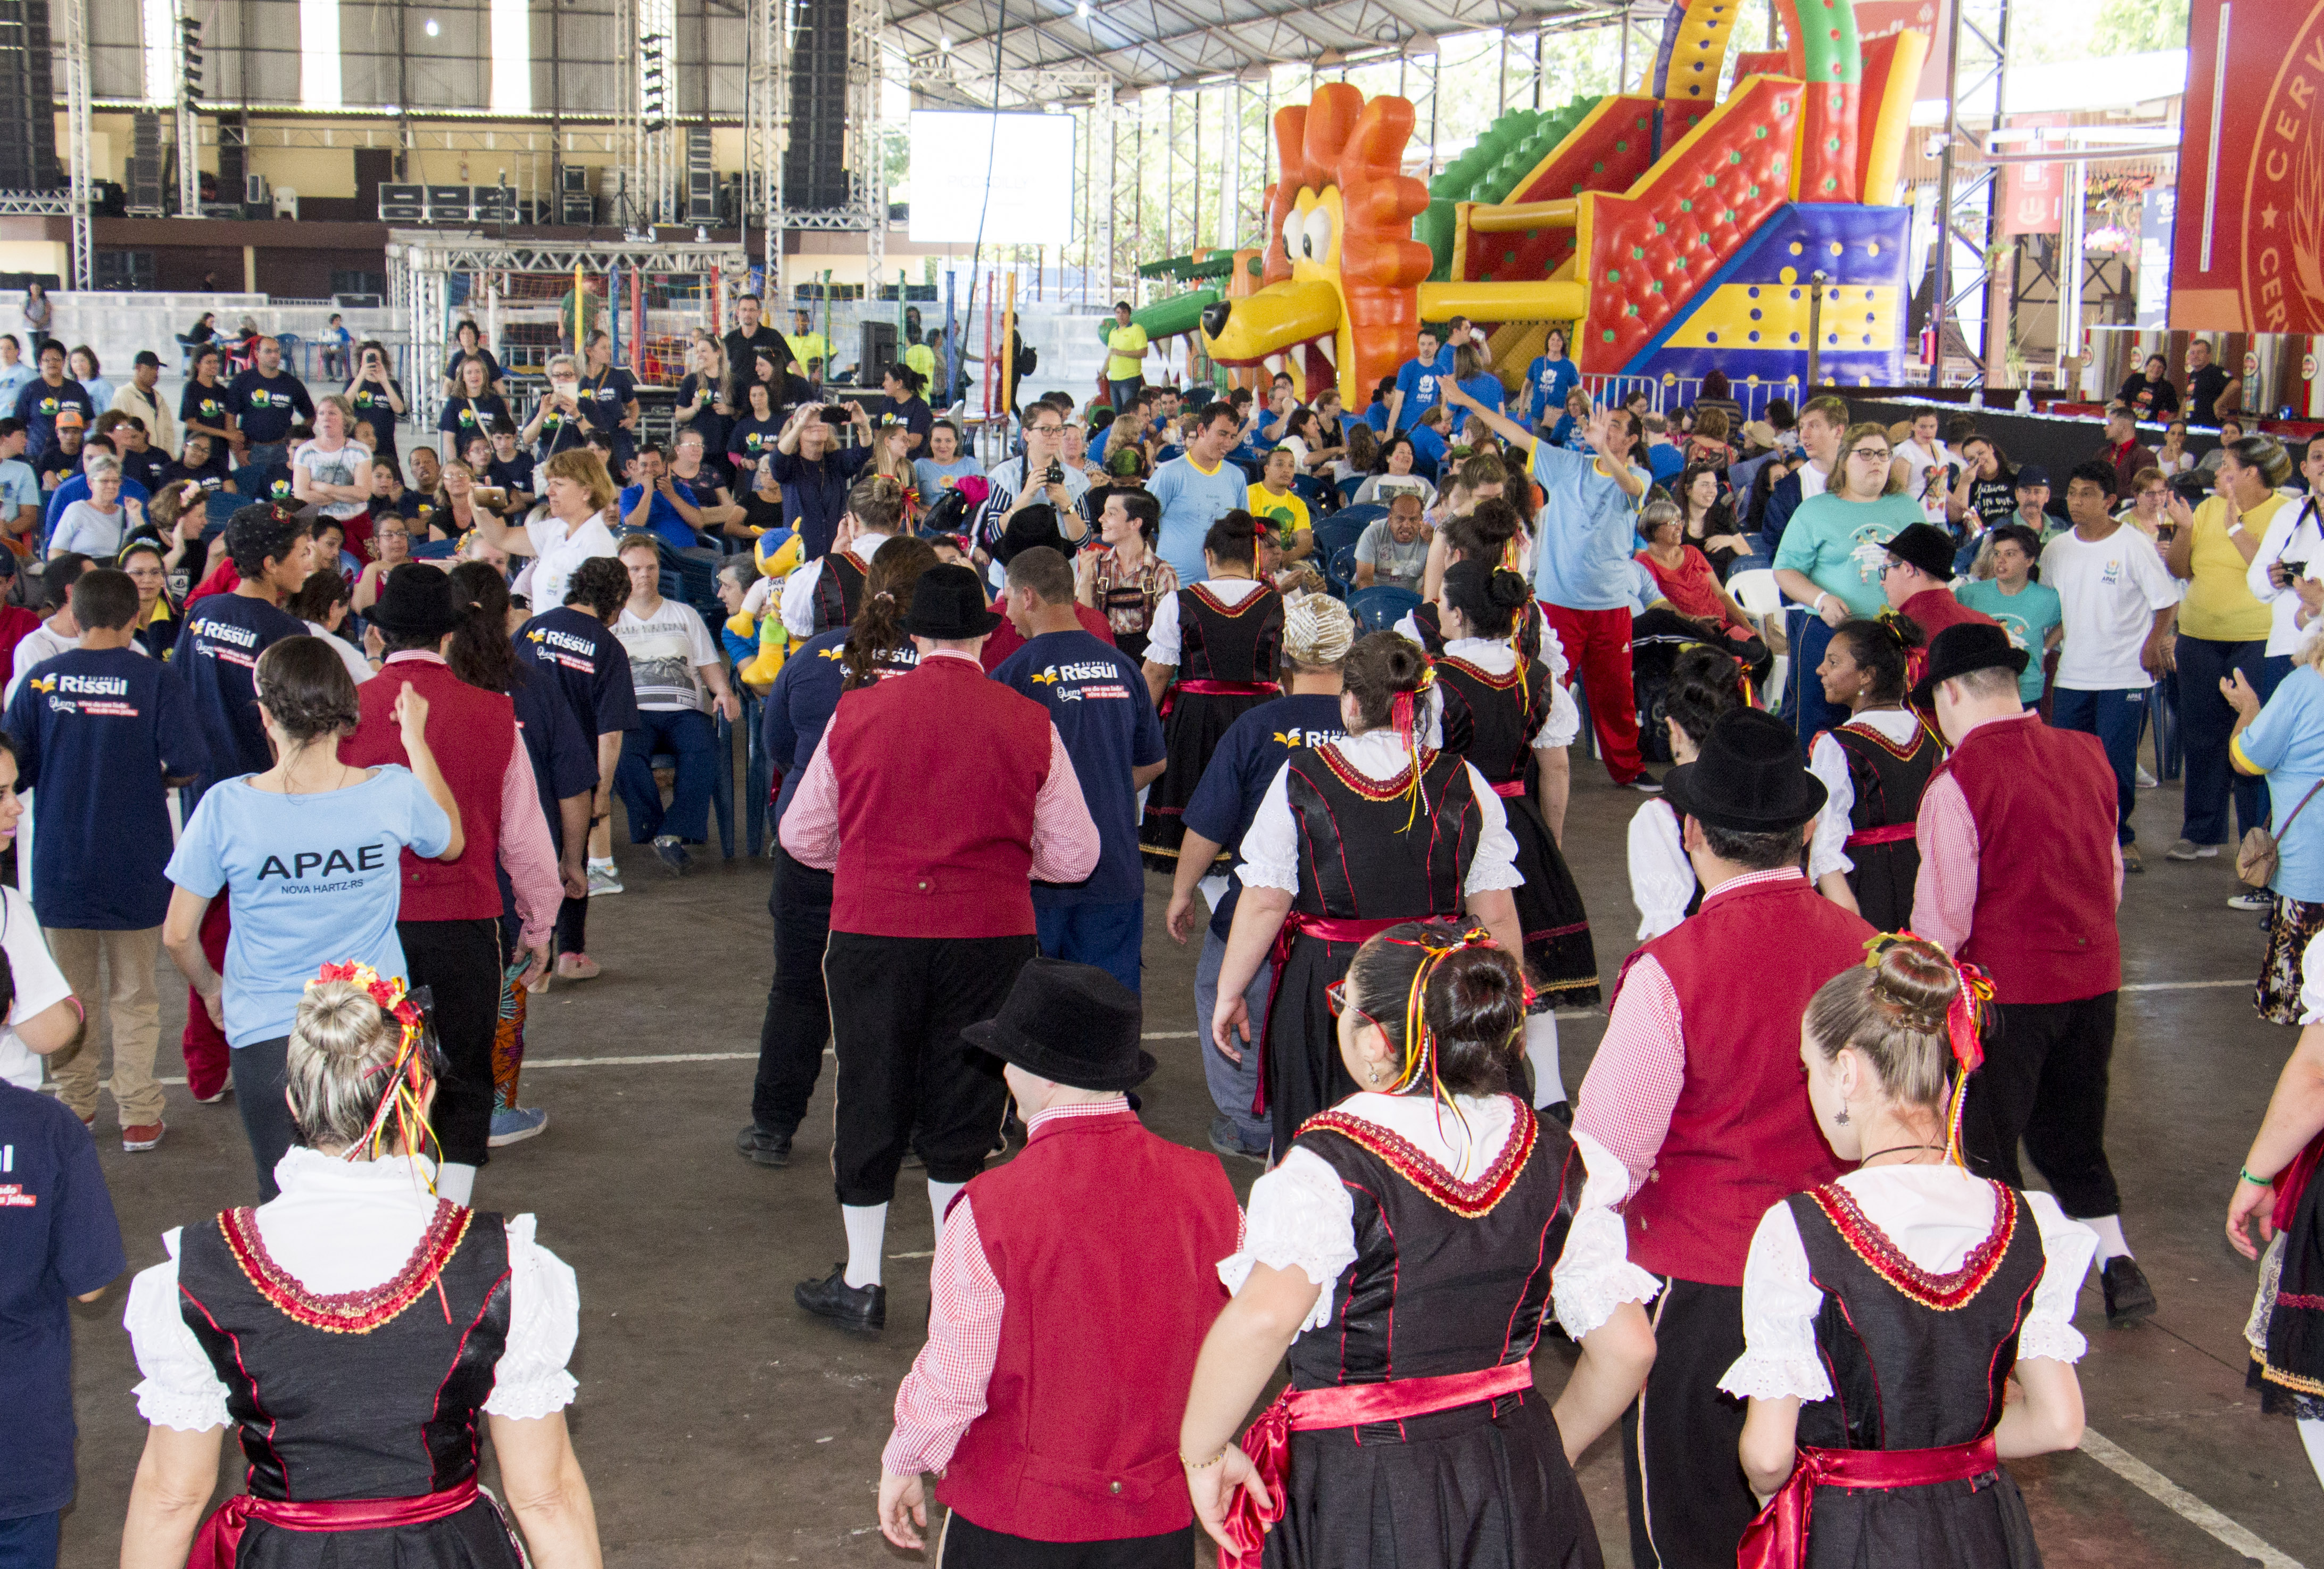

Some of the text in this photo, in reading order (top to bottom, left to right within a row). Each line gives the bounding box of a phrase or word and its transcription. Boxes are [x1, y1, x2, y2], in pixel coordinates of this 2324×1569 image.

[2260, 247, 2289, 333] CER
[271, 394, 290, 403] APAE
[768, 577, 785, 587] BRAS
[871, 648, 920, 665] issul
[1059, 662, 1118, 682] Rissul
[60, 675, 128, 695] Rissul
[1306, 729, 1340, 748] Ris
[257, 844, 384, 881] APAE
[281, 879, 363, 894] NOVA HARTZ-RS
